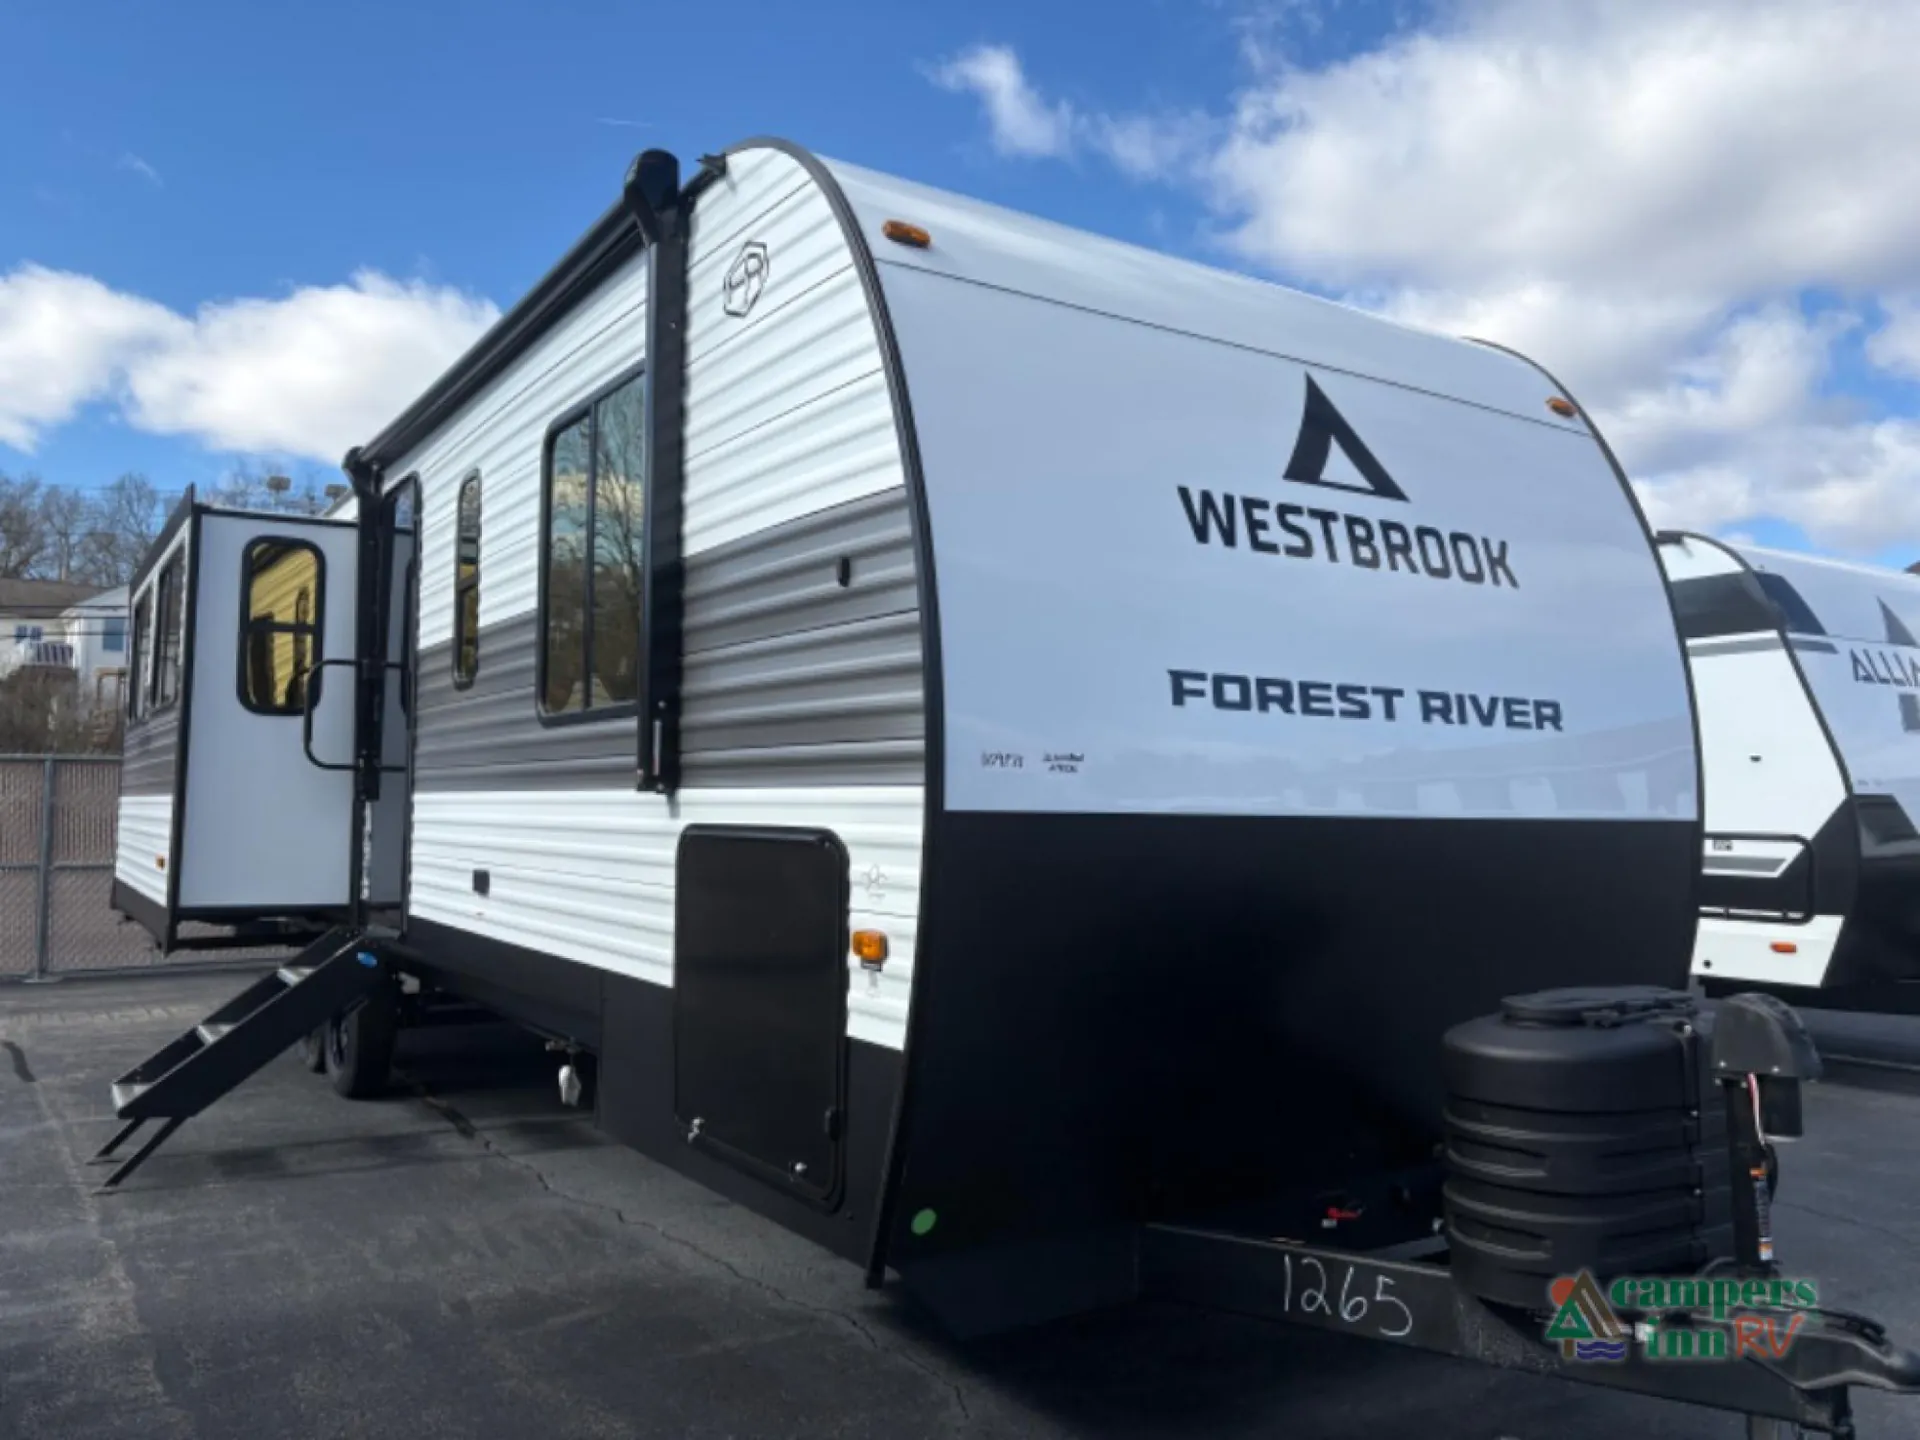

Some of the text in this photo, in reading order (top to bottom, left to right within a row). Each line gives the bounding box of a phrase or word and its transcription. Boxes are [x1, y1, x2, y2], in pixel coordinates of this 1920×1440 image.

[1177, 485, 1520, 589] WESTBROOK
[1167, 669, 1563, 732] FOREST RIVER
[1283, 1254, 1414, 1336] 1265
